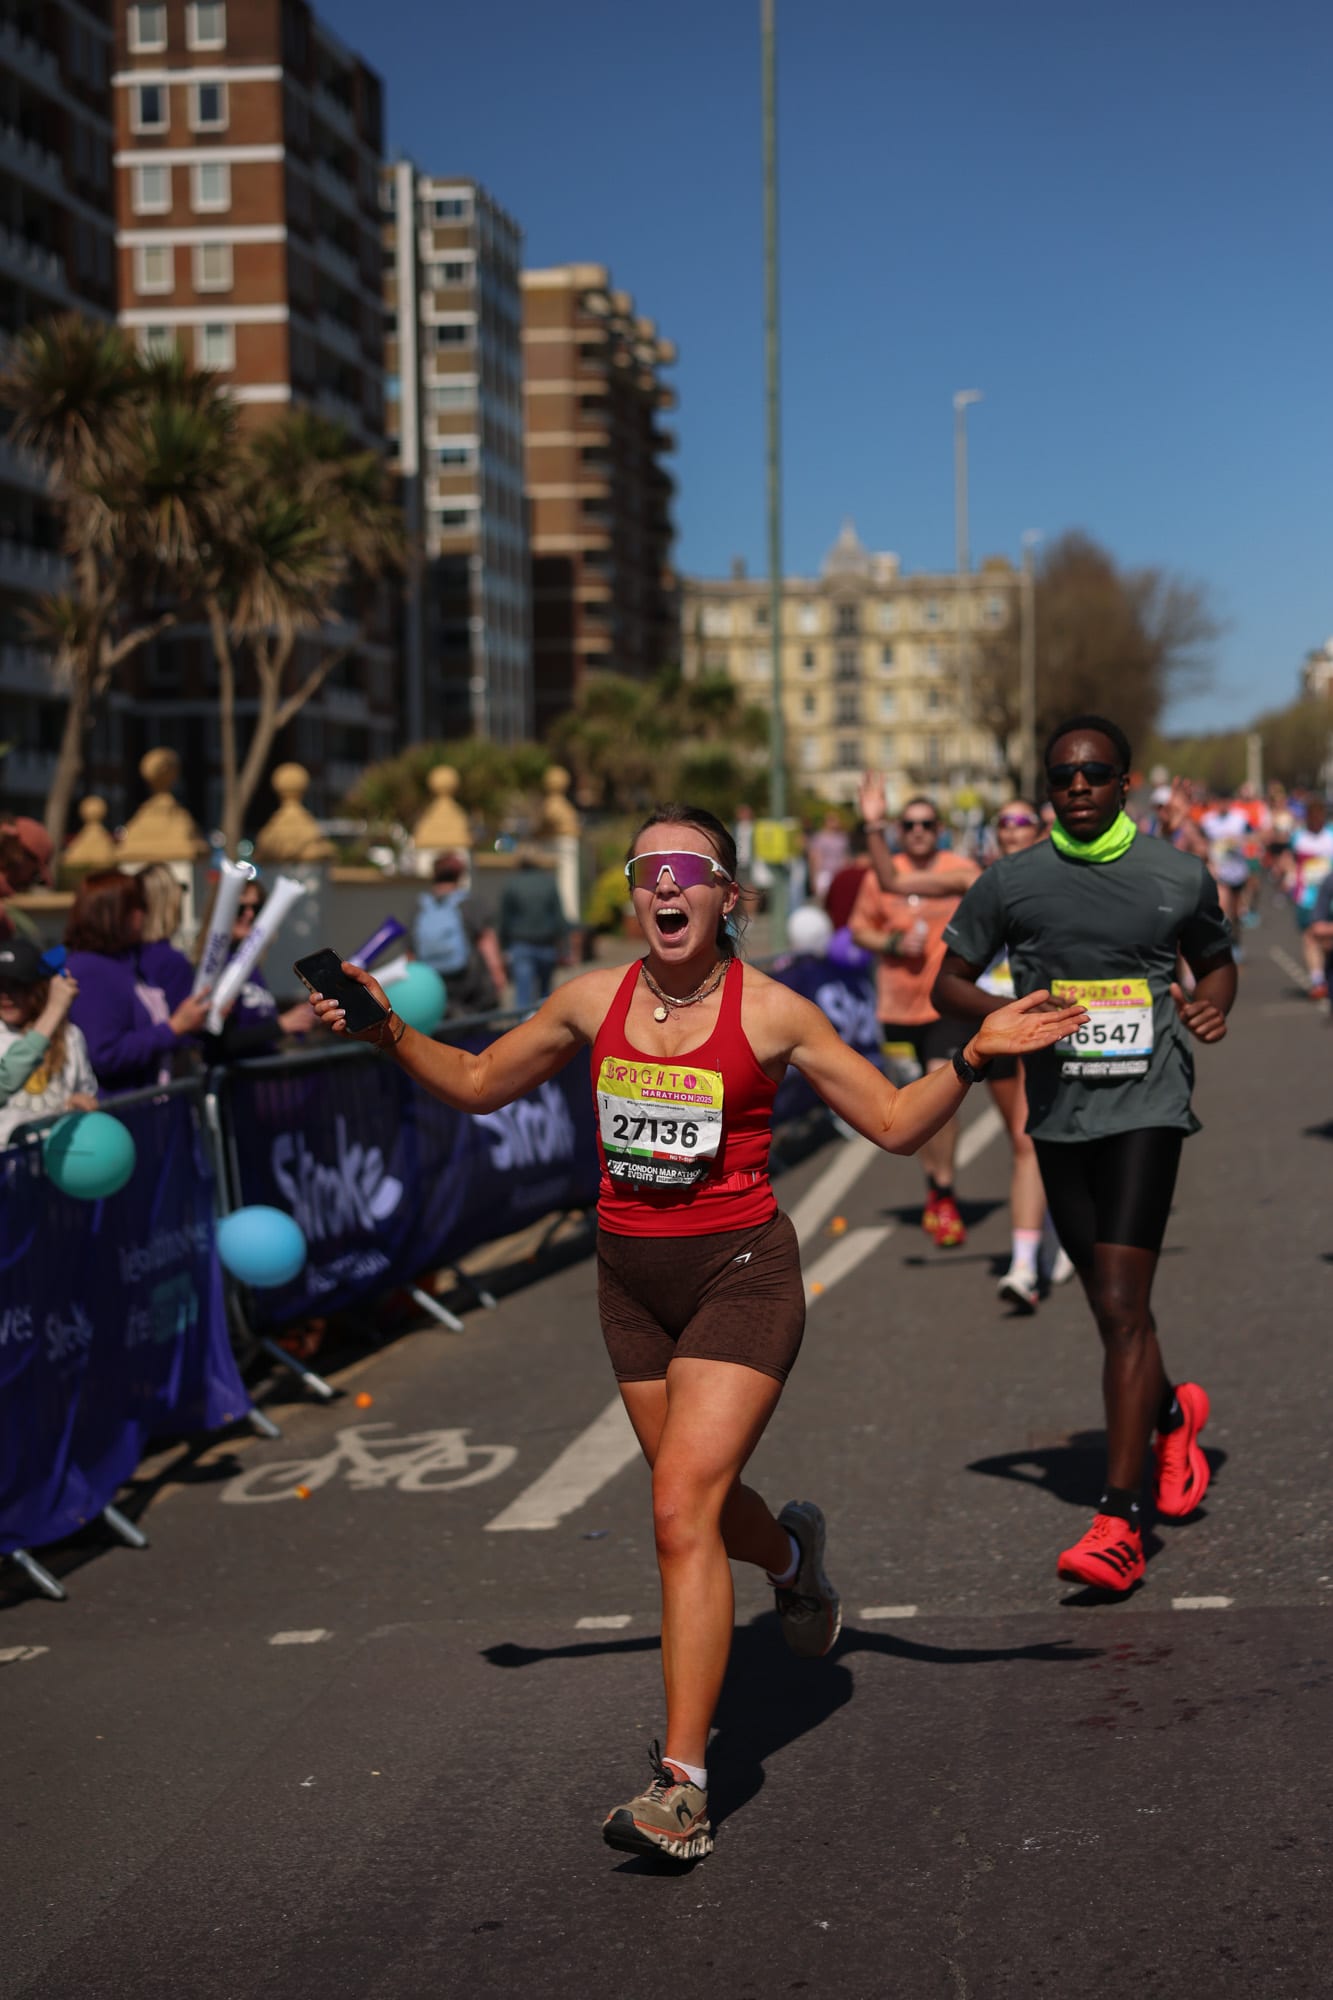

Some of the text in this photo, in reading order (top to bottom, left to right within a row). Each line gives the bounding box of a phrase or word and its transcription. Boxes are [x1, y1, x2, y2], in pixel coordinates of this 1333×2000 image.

[605, 1062, 714, 1091] BRIGHTON
[603, 1099, 609, 1110] 1
[641, 1089, 713, 1105] MARATHON 2025
[613, 1114, 699, 1149] 27136
[627, 1171, 653, 1182] EVENTS
[628, 1163, 702, 1179] LONDON MARATHON
